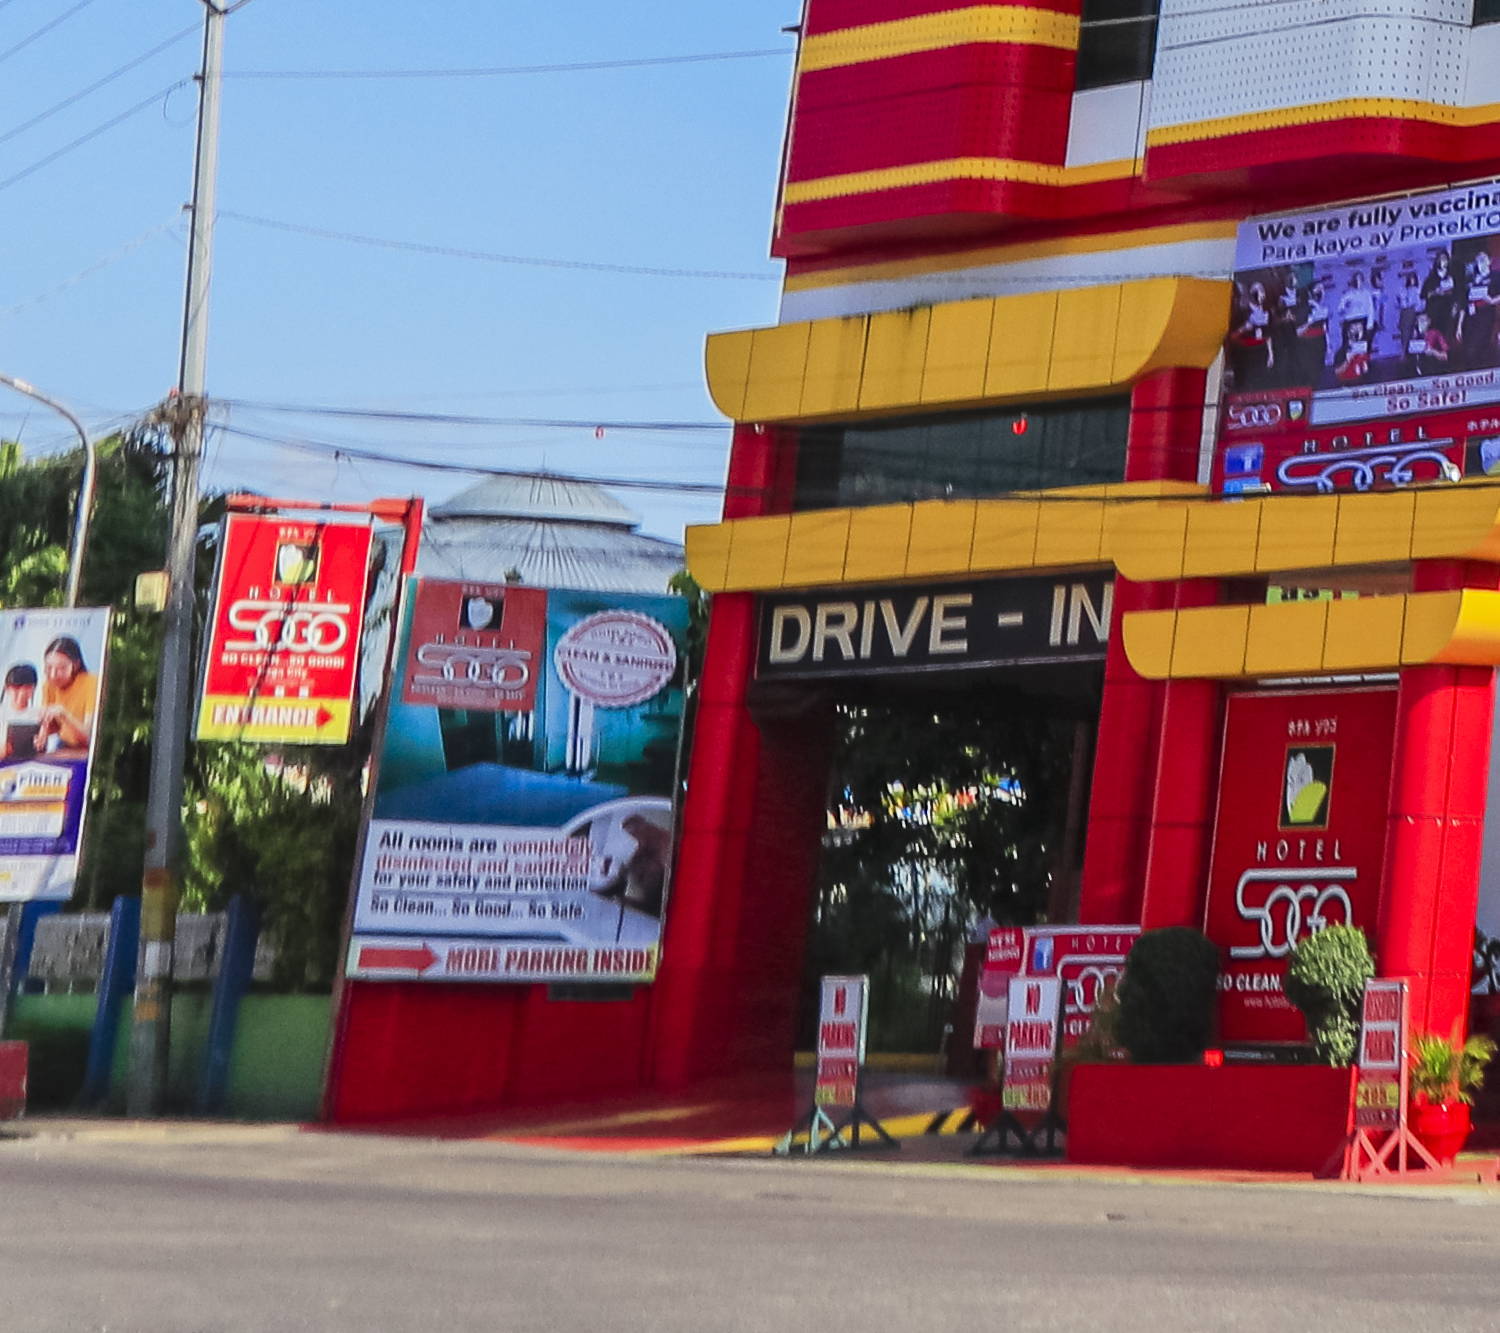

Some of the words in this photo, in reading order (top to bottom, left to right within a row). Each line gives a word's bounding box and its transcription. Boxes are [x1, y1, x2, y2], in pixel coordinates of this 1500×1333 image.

[1258, 222, 1296, 242] We
[1303, 215, 1341, 235] are
[1348, 204, 1403, 231] fully
[1261, 238, 1308, 263] Para
[1313, 233, 1364, 258] kayo
[1369, 229, 1392, 250] ay
[1386, 396, 1410, 412] So
[1303, 425, 1427, 454] HOTEL
[769, 593, 974, 665] DRIVE
[1049, 582, 1114, 647] IN
[379, 830, 403, 850] All
[408, 834, 464, 852] rooms
[469, 837, 497, 853] are
[1257, 839, 1342, 862] HOTEL
[477, 856, 509, 874] and
[373, 872, 393, 887] for
[398, 874, 430, 890] your
[436, 876, 480, 893] safety
[484, 876, 511, 890] and
[370, 896, 389, 914] So
[452, 900, 470, 917] So
[528, 900, 547, 918] So
[504, 947, 590, 974] PARKING
[592, 947, 655, 975] INSIDE
